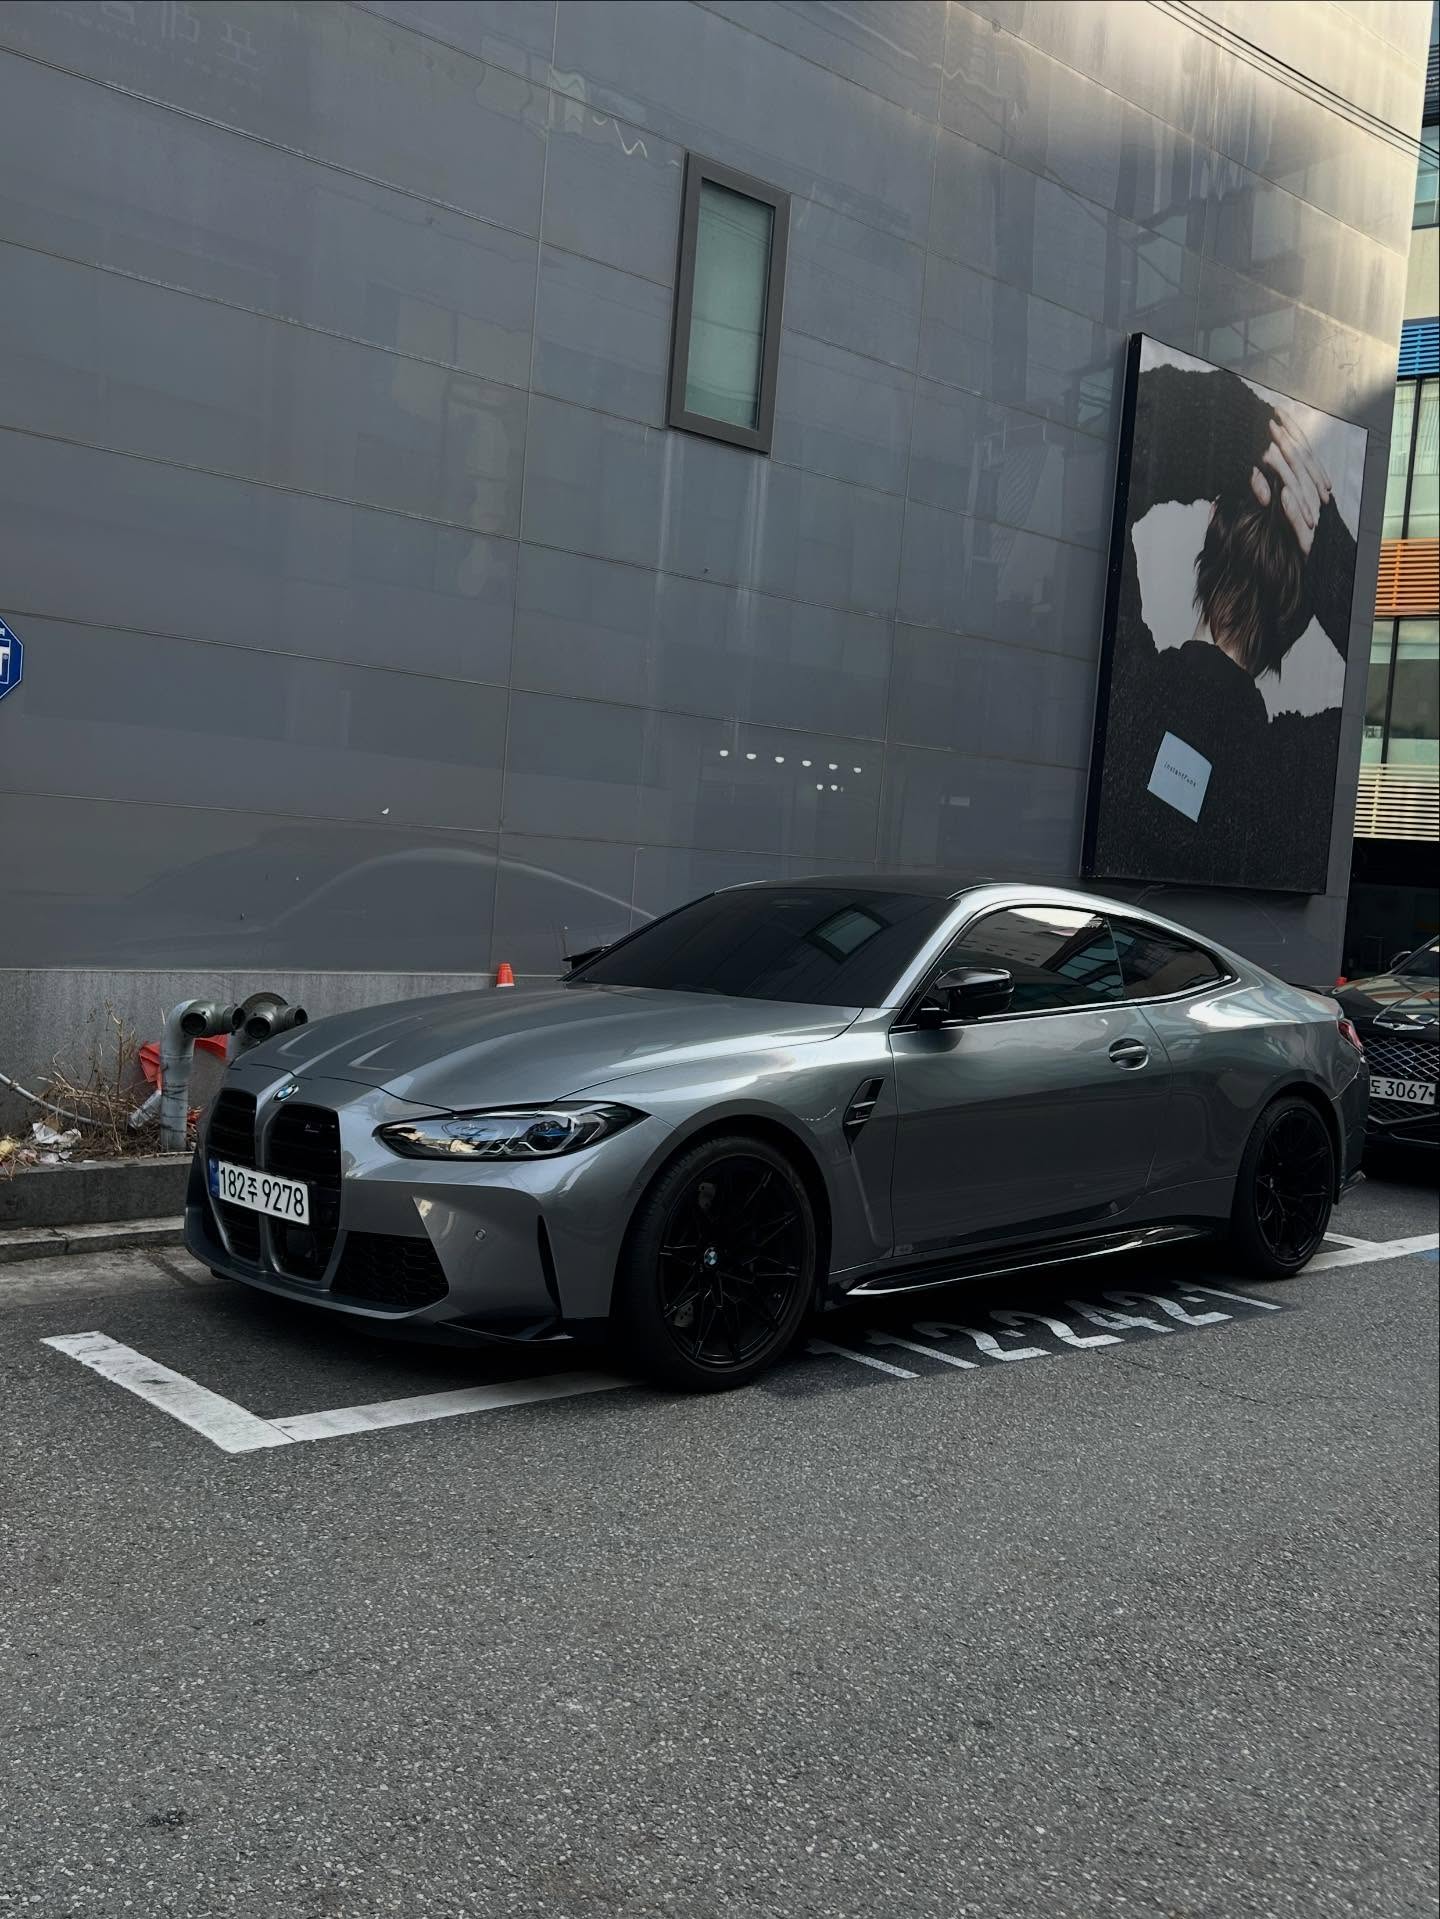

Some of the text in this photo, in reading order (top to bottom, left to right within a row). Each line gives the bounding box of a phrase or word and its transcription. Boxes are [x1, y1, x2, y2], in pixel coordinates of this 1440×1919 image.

[1384, 1080, 1430, 1101] 3067
[220, 1166, 305, 1217] 182주 9278
